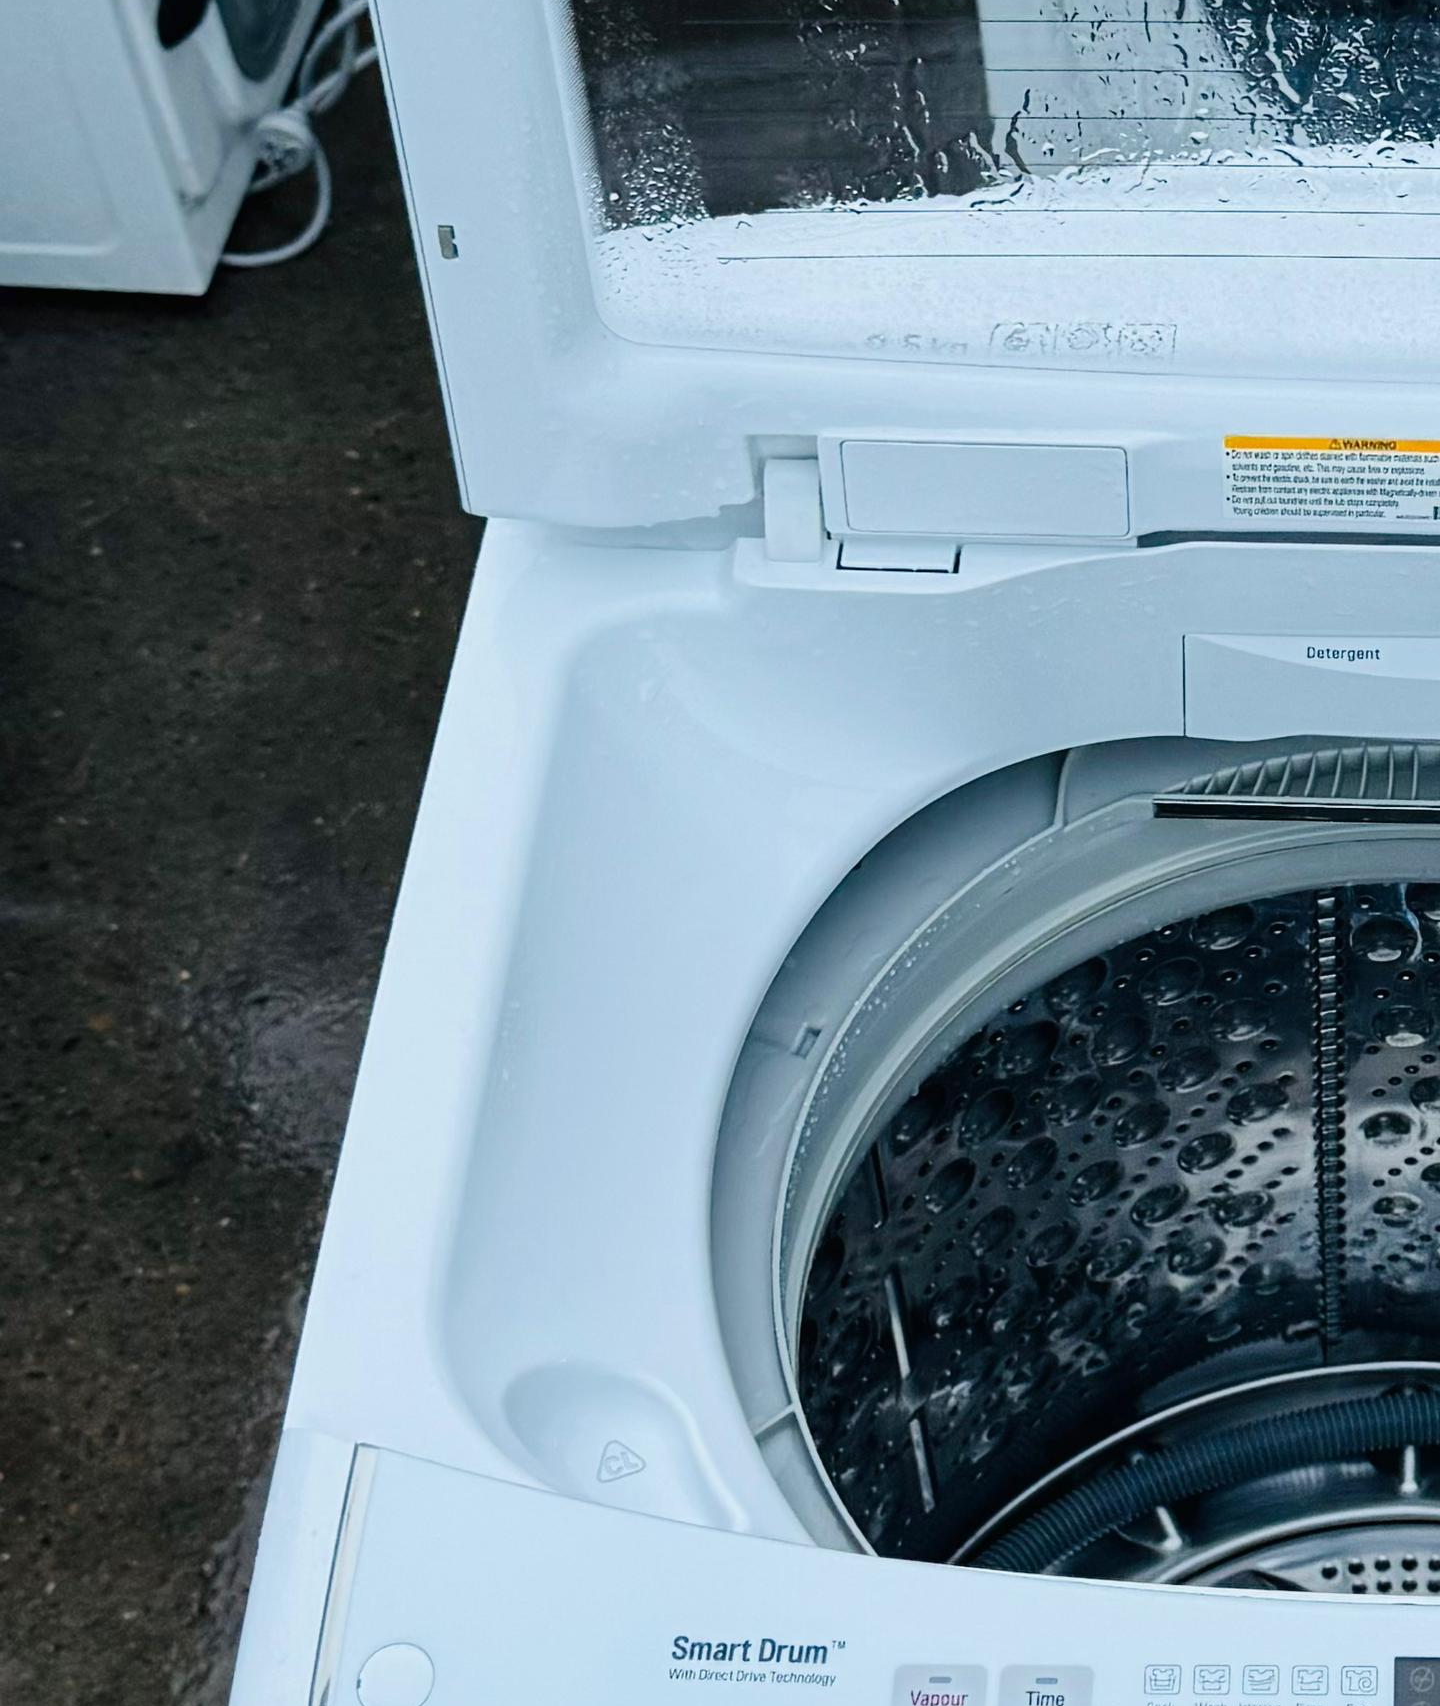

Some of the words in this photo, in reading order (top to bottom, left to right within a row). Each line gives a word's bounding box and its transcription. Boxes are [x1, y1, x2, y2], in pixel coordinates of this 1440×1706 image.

[1343, 440, 1397, 451] WARNING
[1307, 646, 1380, 663] Detergent
[672, 1636, 752, 1662] Smart
[669, 1669, 696, 1680] With
[699, 1669, 733, 1681] Direct
[736, 1671, 766, 1682] Drive
[771, 1672, 836, 1687] Technology
